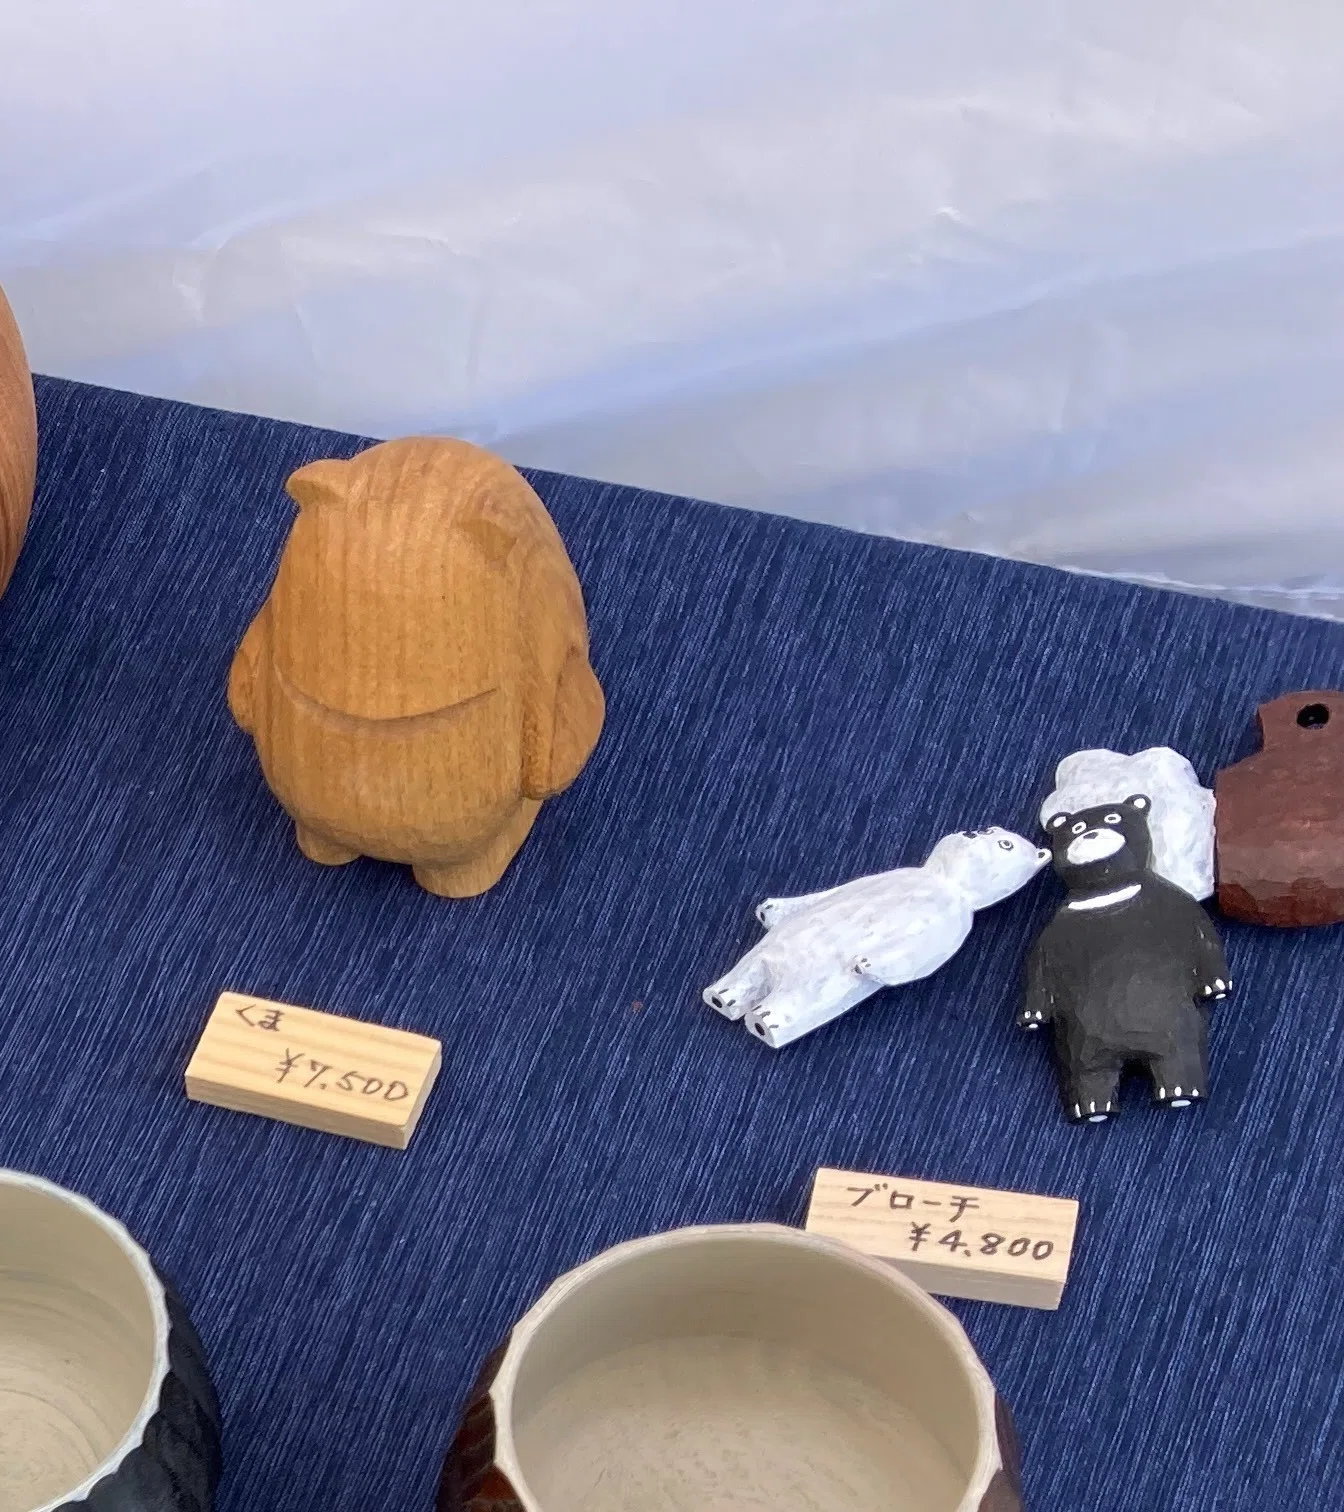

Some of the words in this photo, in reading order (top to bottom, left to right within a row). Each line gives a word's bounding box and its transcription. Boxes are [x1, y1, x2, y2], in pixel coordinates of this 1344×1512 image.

[236, 1003, 284, 1032] くま
[846, 1183, 980, 1223] ブローチ
